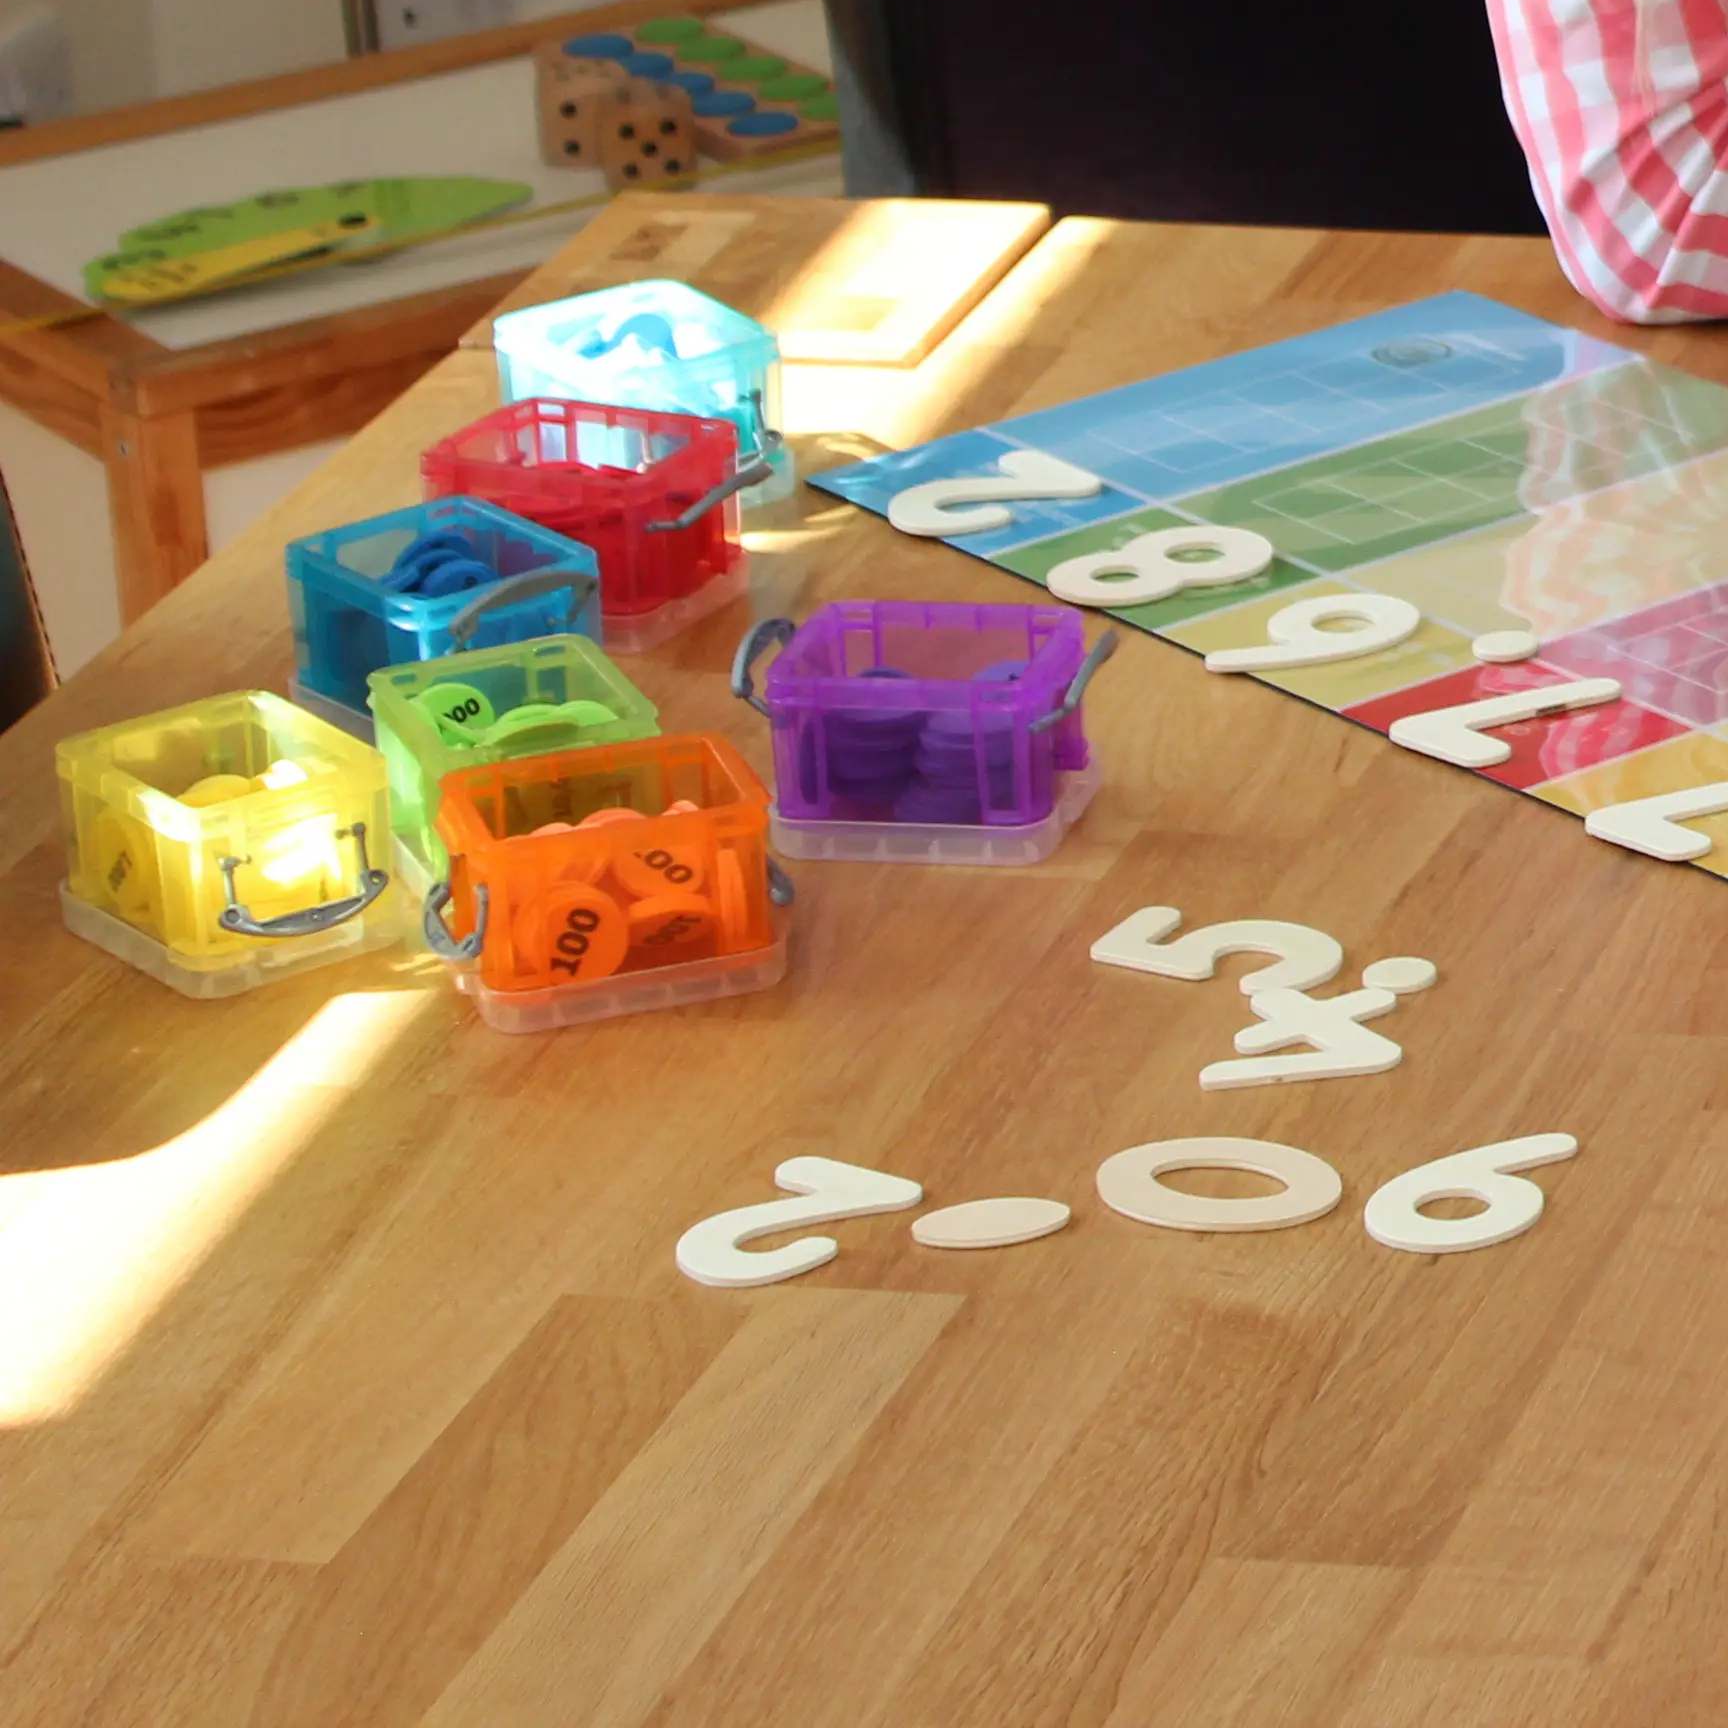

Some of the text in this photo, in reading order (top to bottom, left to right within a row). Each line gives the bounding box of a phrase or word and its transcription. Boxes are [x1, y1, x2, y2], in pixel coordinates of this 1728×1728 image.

[887, 449, 1102, 537] 2
[1046, 525, 1274, 608] 8
[550, 908, 601, 977] 100
[1090, 904, 1344, 996] 5
[1199, 987, 1403, 1090] 4
